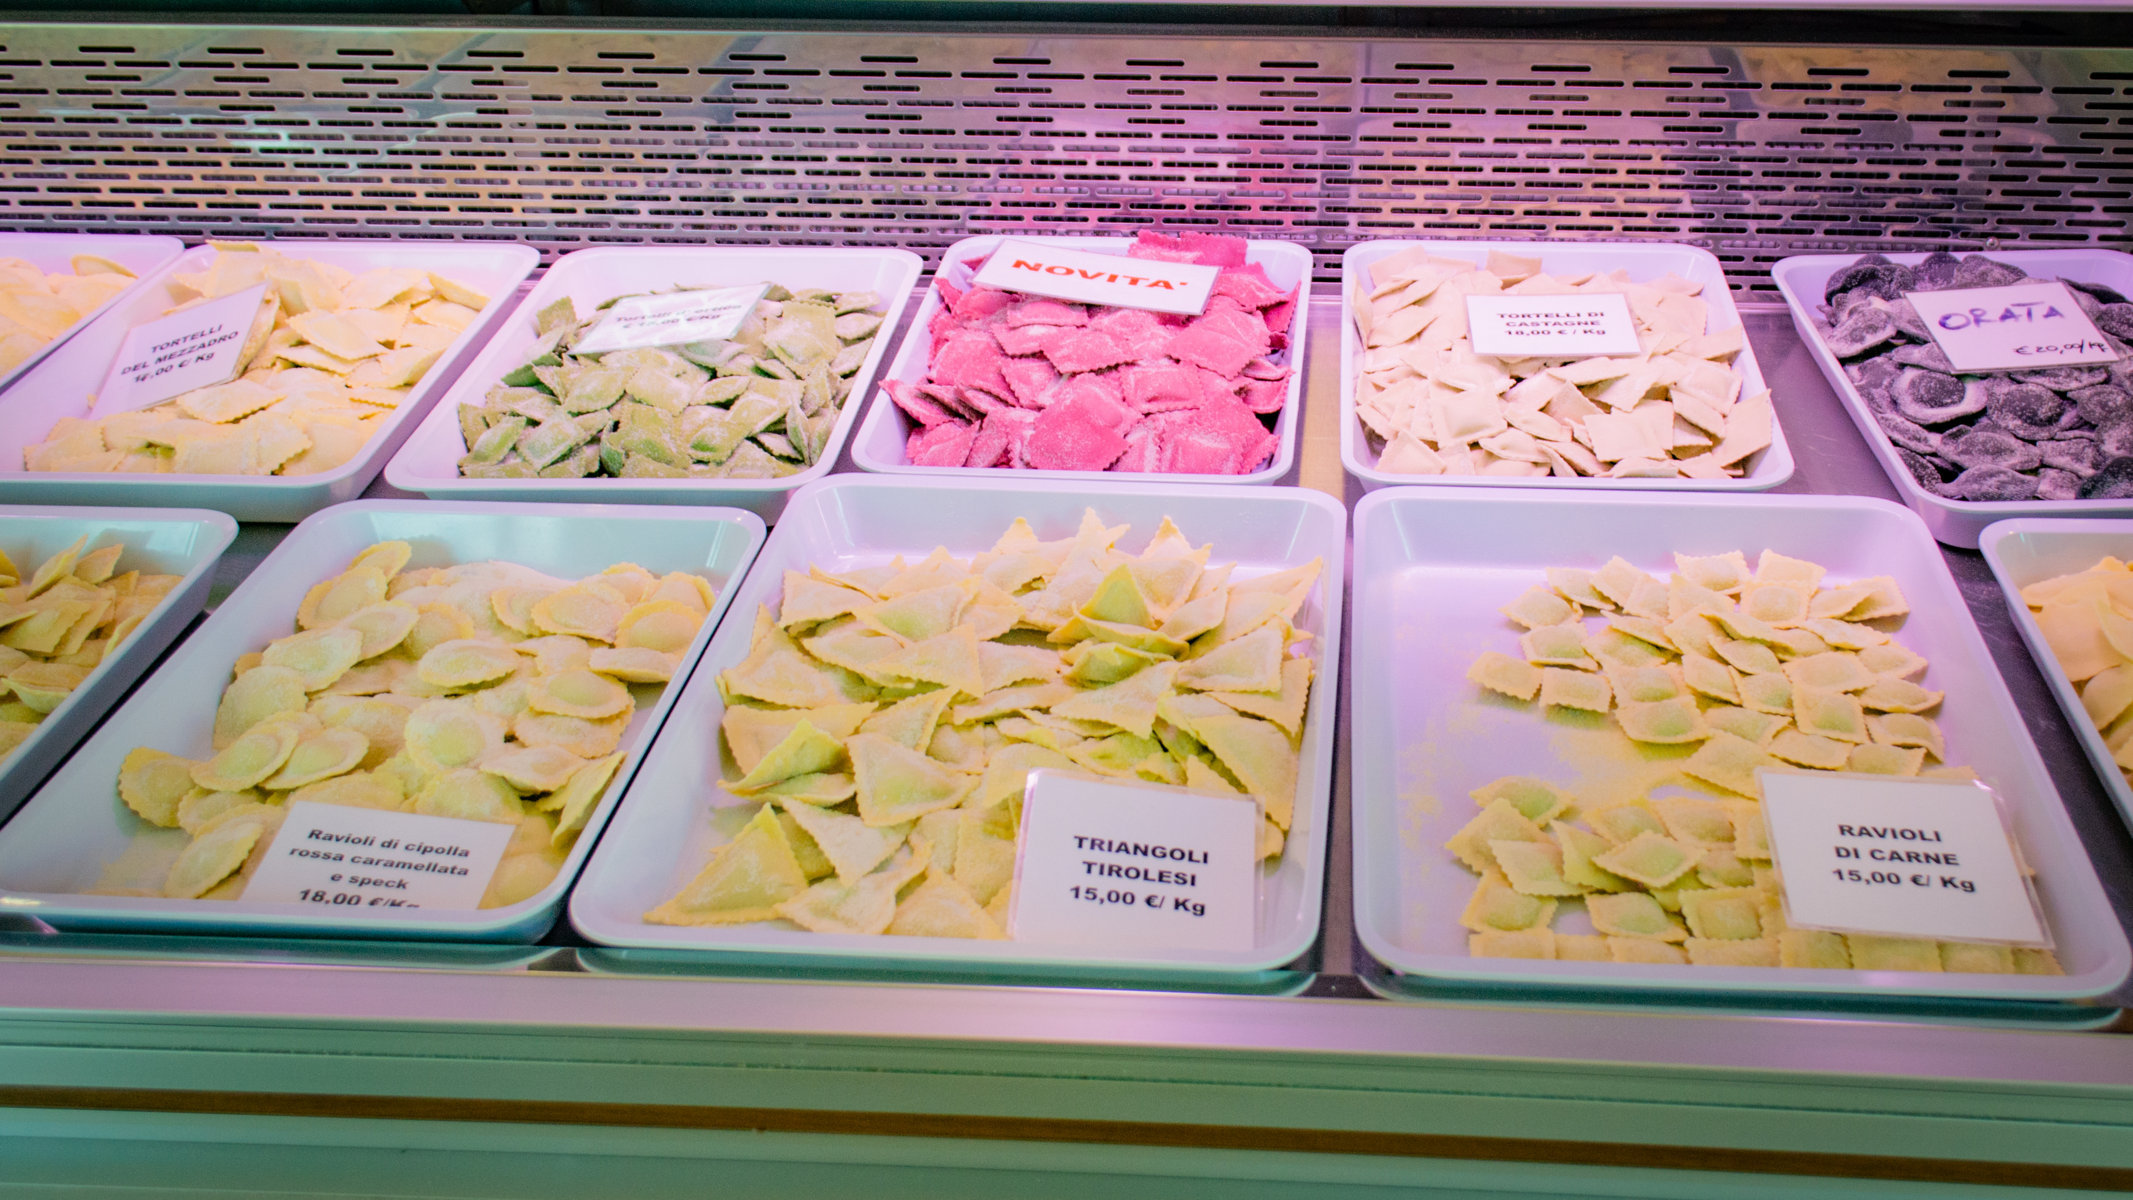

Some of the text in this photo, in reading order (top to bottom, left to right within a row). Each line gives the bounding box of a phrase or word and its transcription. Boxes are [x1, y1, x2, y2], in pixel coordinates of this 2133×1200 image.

[1012, 259, 1188, 290] NOVITA'
[1938, 301, 2065, 331] ORATA
[151, 323, 224, 353] TORTELLI
[1583, 329, 1606, 337] Kg
[121, 330, 239, 376] DEL MEZZADRO
[194, 352, 216, 364] Kg
[308, 828, 471, 858] Ravioli di cipolla
[1838, 824, 1942, 842] RAVIOLI
[289, 847, 470, 877] rossa caramellata
[1073, 835, 1209, 865] TRIANGOLI
[1835, 846, 1960, 866] DI CARNE
[330, 871, 410, 890] e speck
[1082, 861, 1197, 887] TIROLESI
[1832, 869, 1902, 885] 15,00
[1940, 876, 1976, 893] Kg
[1070, 885, 1136, 906] 15,00
[1173, 898, 1206, 917] Kg
